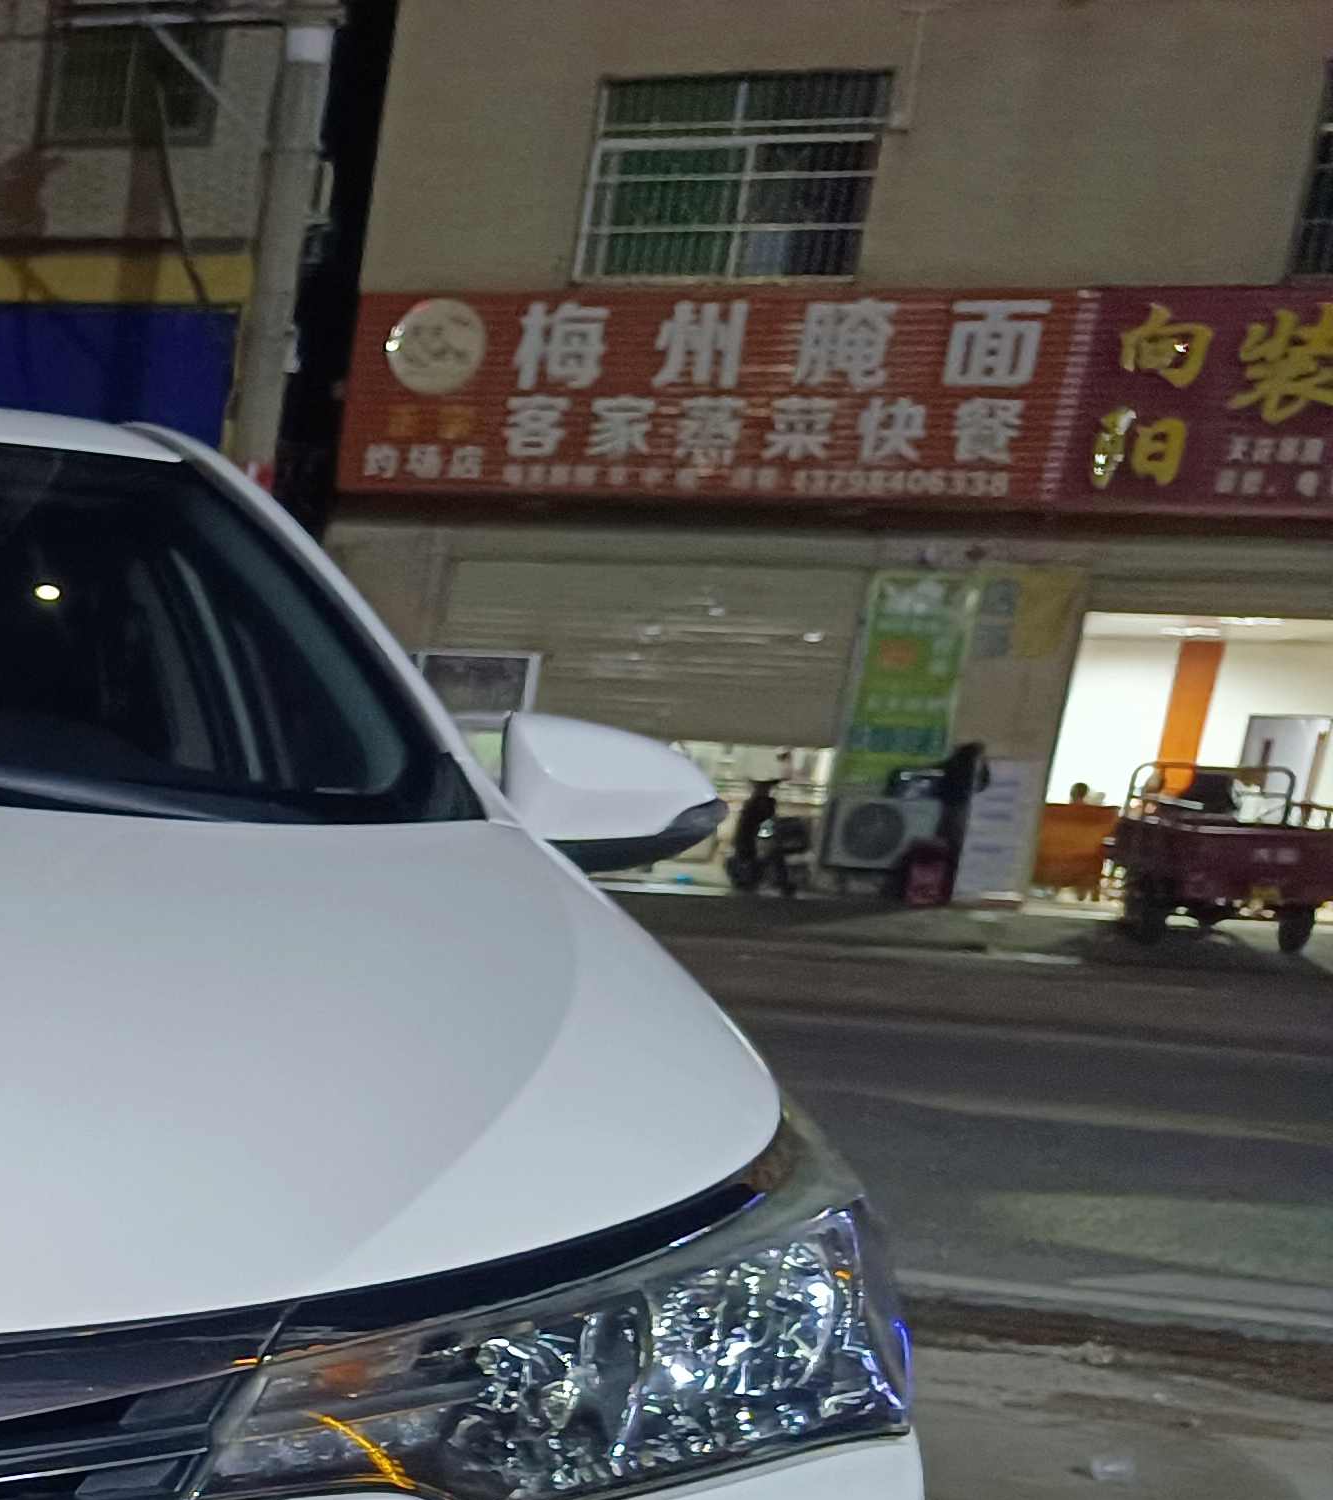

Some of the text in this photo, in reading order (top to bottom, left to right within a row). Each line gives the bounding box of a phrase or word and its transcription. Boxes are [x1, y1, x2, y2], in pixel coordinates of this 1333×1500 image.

[514, 298, 1053, 391] 梅州腌面
[504, 395, 1026, 465] 客家蒸菜快餐
